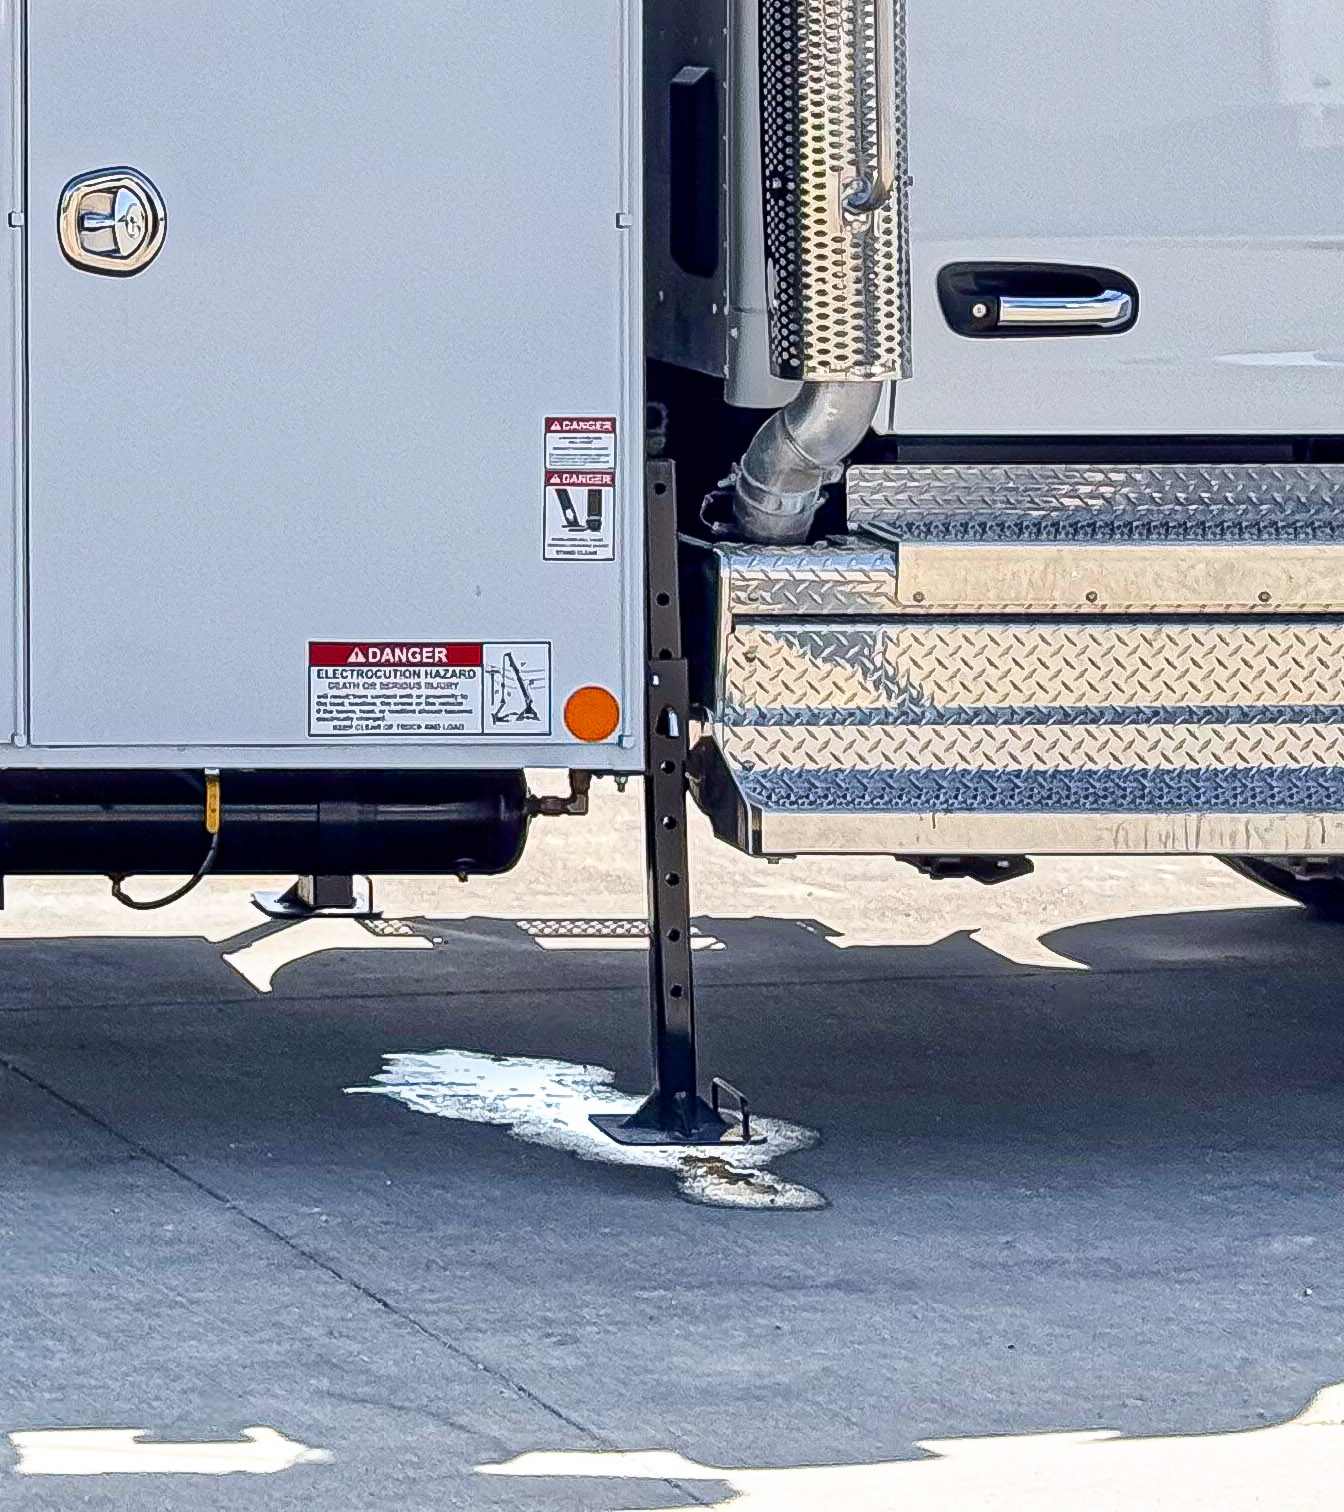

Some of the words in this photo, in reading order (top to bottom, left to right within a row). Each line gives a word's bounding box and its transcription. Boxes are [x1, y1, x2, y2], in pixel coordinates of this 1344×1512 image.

[562, 420, 612, 431] DANGER
[562, 474, 612, 484] DANGER
[368, 647, 449, 663] DANGER
[317, 669, 421, 679] ELECTROCUTION
[425, 669, 476, 679] HAZARD
